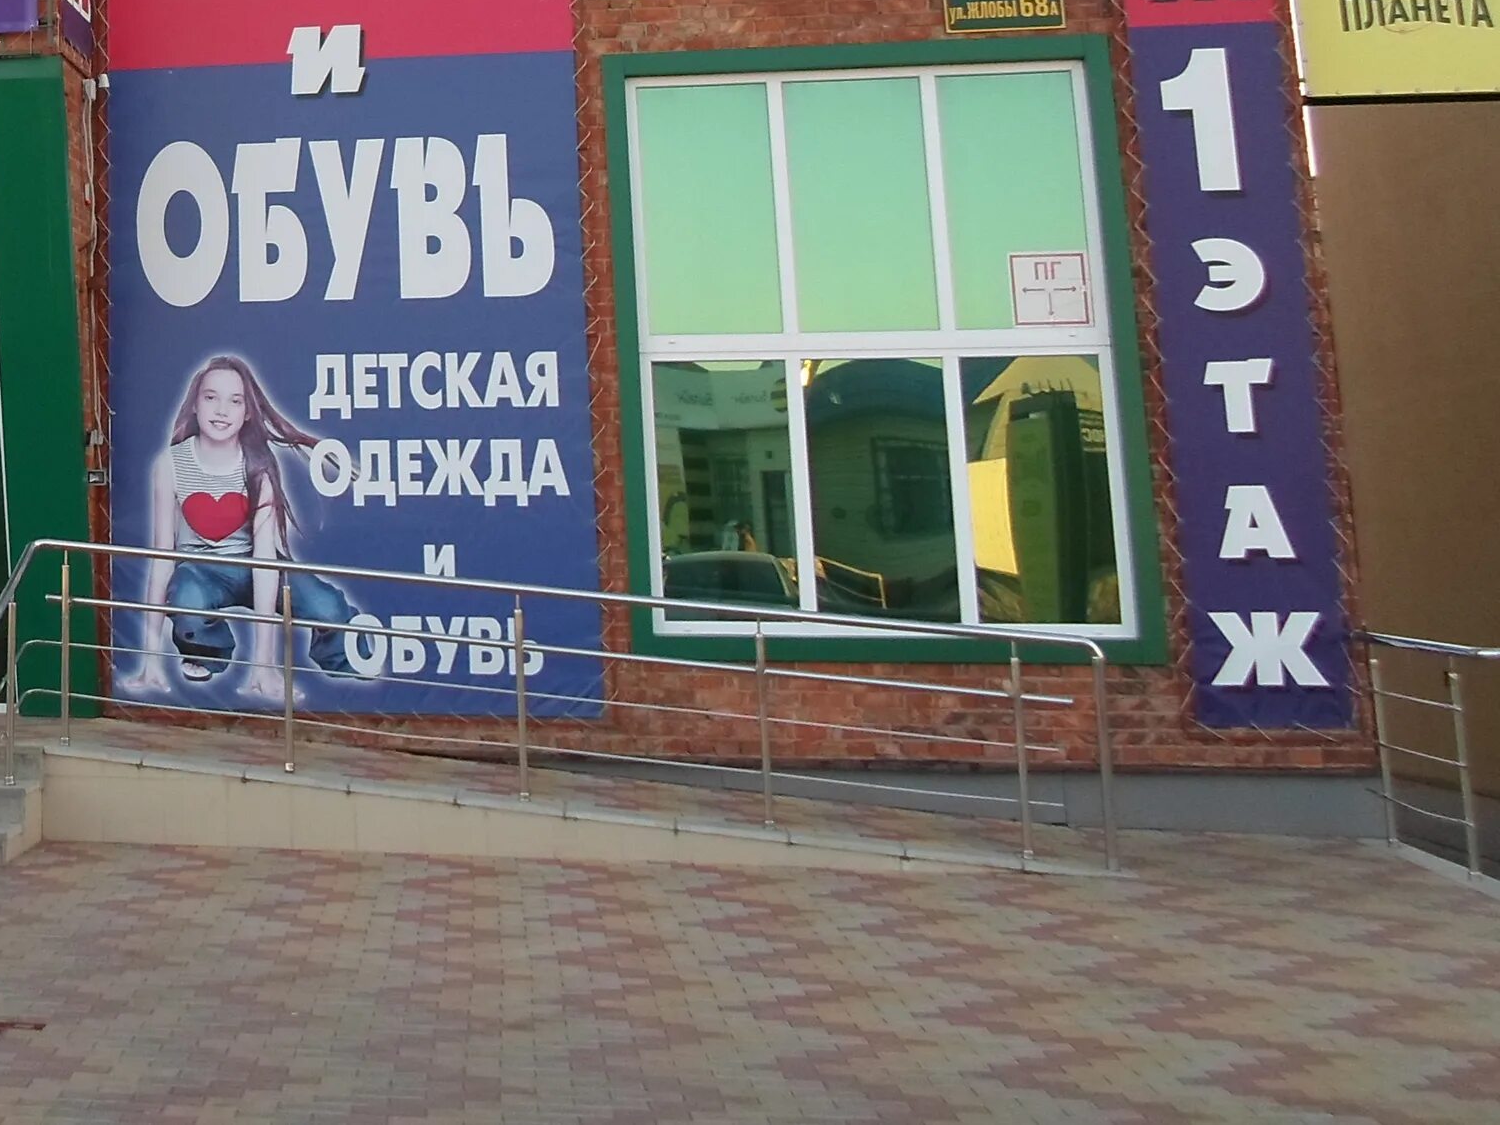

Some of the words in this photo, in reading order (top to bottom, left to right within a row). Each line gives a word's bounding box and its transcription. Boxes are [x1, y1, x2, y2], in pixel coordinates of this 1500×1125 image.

[1159, 47, 1242, 193] 1
[136, 133, 556, 307] ОБУВЬ
[309, 350, 560, 420] ДЕТСКАЯ
[310, 438, 572, 506] ОДЕЖДА
[344, 613, 545, 676] ОБУВЬ
